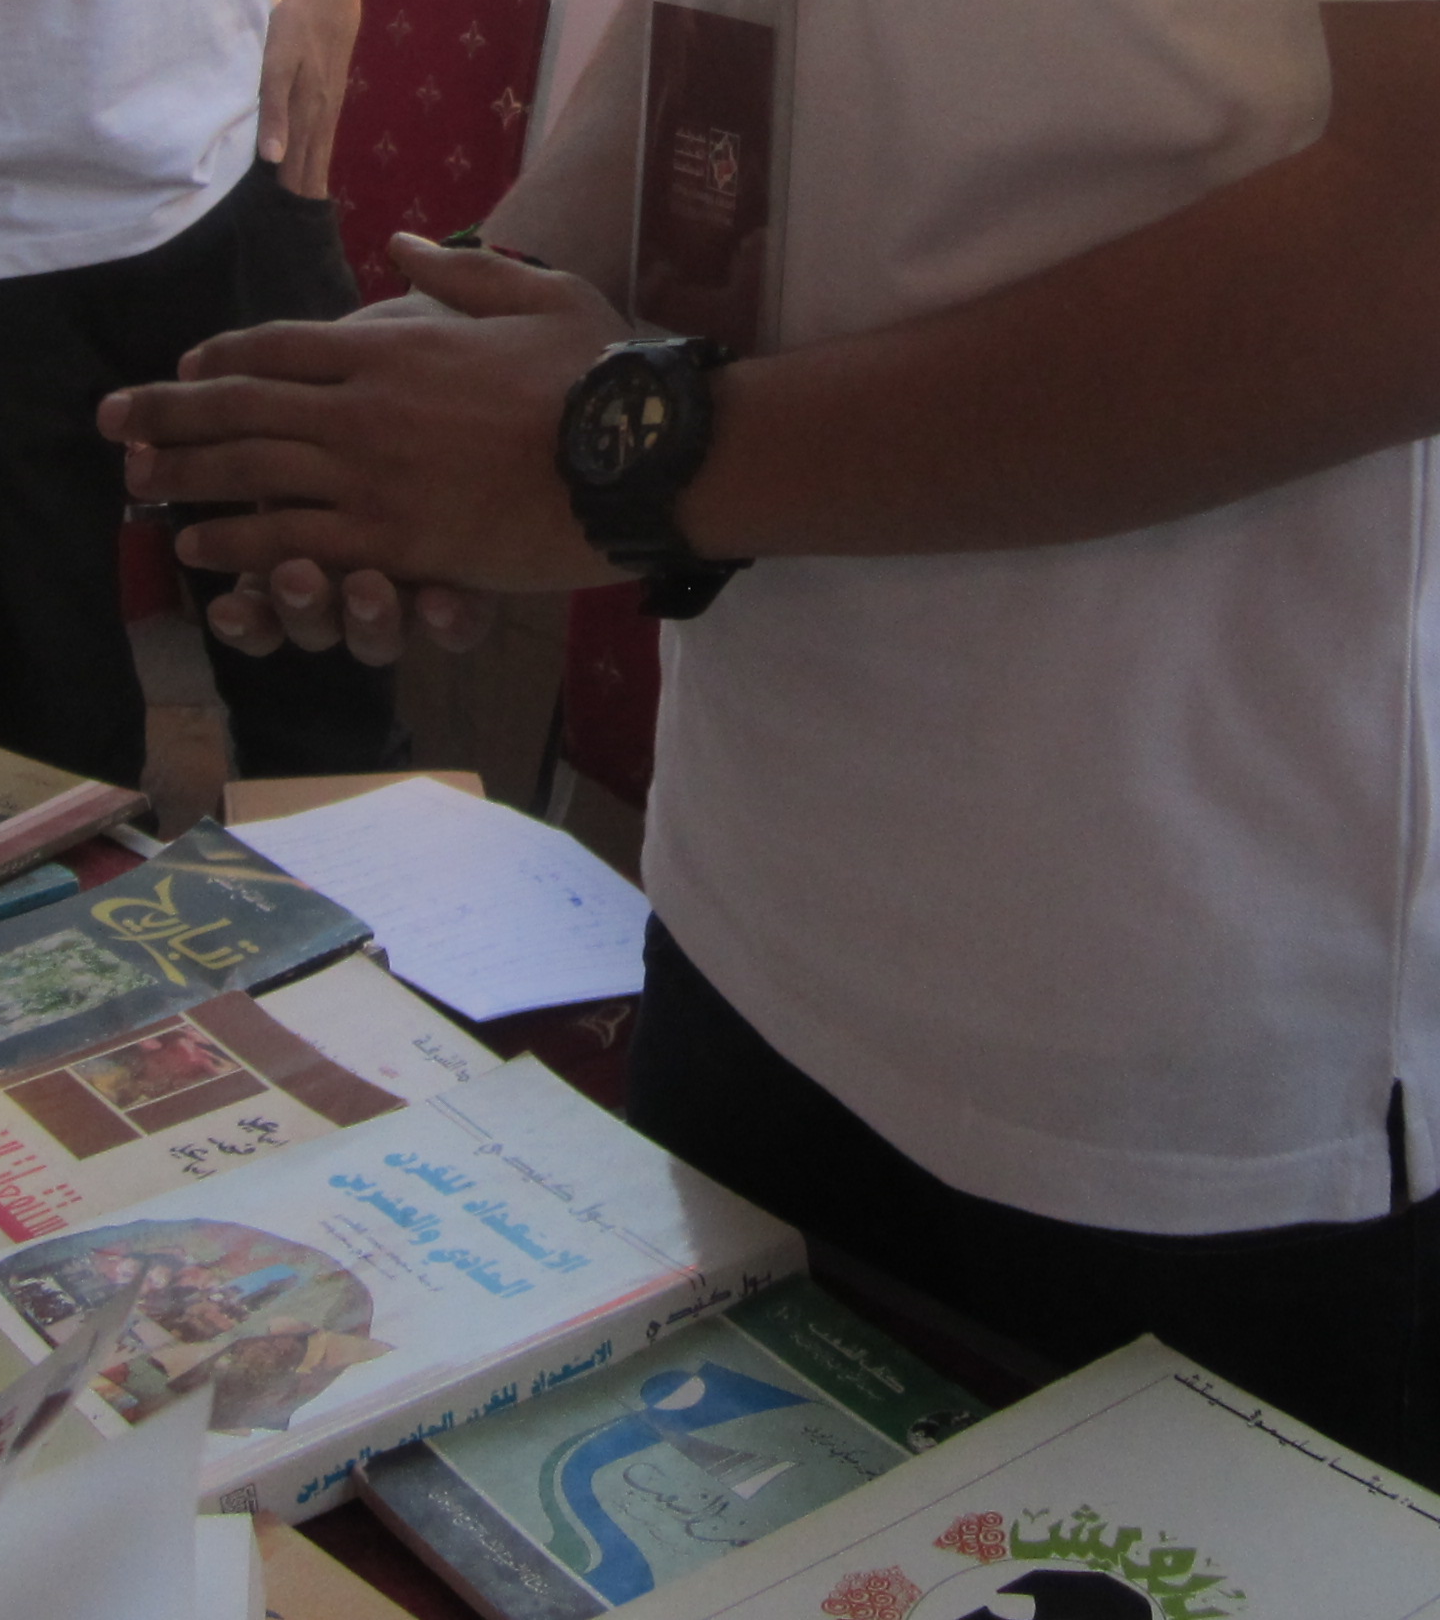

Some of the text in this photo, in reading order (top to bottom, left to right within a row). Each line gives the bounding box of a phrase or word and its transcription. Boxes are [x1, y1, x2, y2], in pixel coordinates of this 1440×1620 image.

[328, 1174, 536, 1298] الحادي والعشرين
[383, 1152, 593, 1274] الاستعداد للقرن
[569, 1201, 616, 1232] بول
[531, 1339, 613, 1398] الاستعداد
